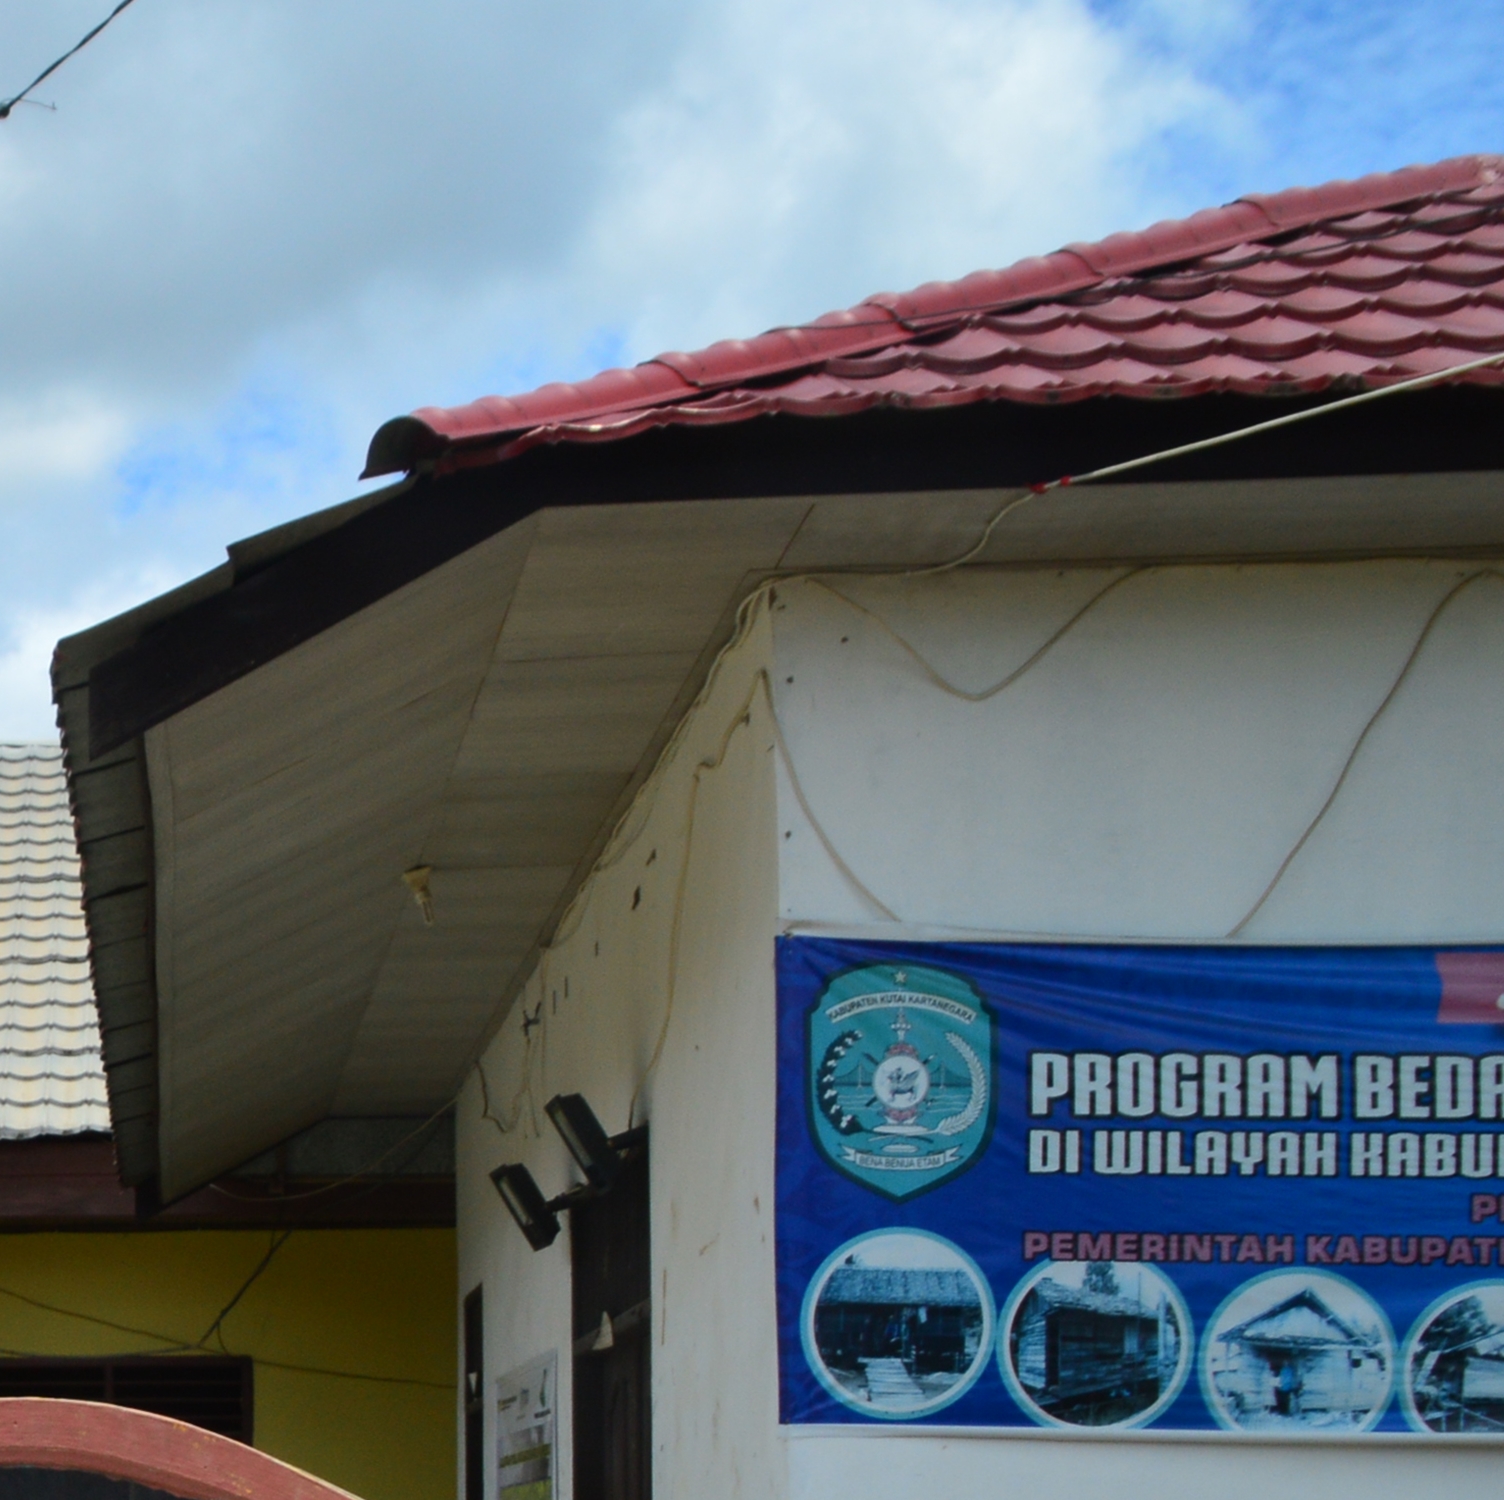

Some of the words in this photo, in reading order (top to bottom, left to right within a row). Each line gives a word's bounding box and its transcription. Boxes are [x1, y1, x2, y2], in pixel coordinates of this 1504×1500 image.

[828, 994, 879, 1019] KABUPATEN
[879, 993, 907, 1004] KUTAI
[908, 994, 973, 1022] KARTANEGARA
[1030, 1052, 1340, 1118] PROGRAM
[1028, 1129, 1080, 1174] DI
[1094, 1130, 1338, 1176] WILAYAH
[1471, 1194, 1504, 1223] P
[1023, 1231, 1294, 1263] PEMERINTAH
[1306, 1235, 1504, 1266] KABUPAT
